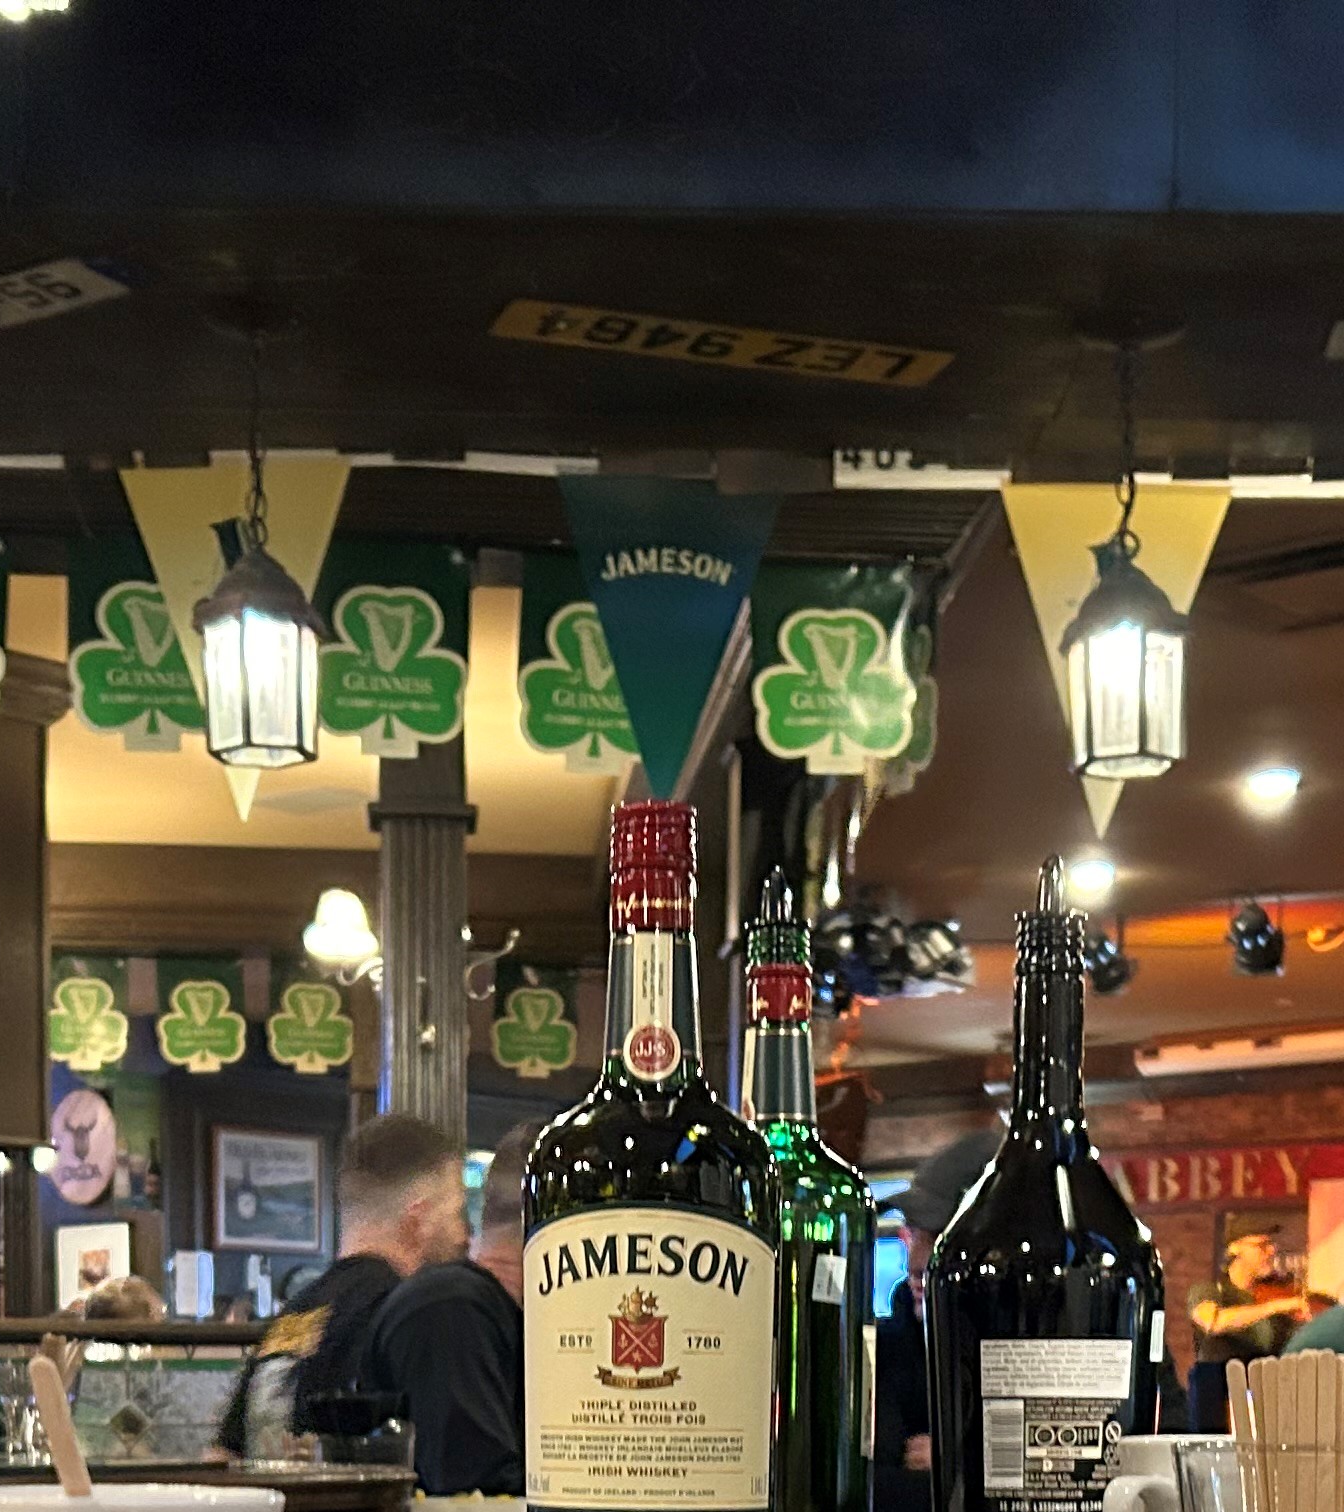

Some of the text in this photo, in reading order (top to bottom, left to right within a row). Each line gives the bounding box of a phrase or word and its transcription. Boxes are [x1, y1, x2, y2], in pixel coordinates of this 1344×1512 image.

[757, 337, 914, 379] LEZ
[601, 548, 732, 586] JAMESON
[342, 673, 433, 695] GUINNESS
[539, 1234, 749, 1297] JAMESON
[686, 1336, 721, 1350] 1780
[581, 1400, 697, 1412] TRIPLE DISTILLED
[632, 1413, 672, 1425] TROIS
[676, 1414, 706, 1426] FOIS
[588, 1466, 688, 1478] IRISH WHISKEY
